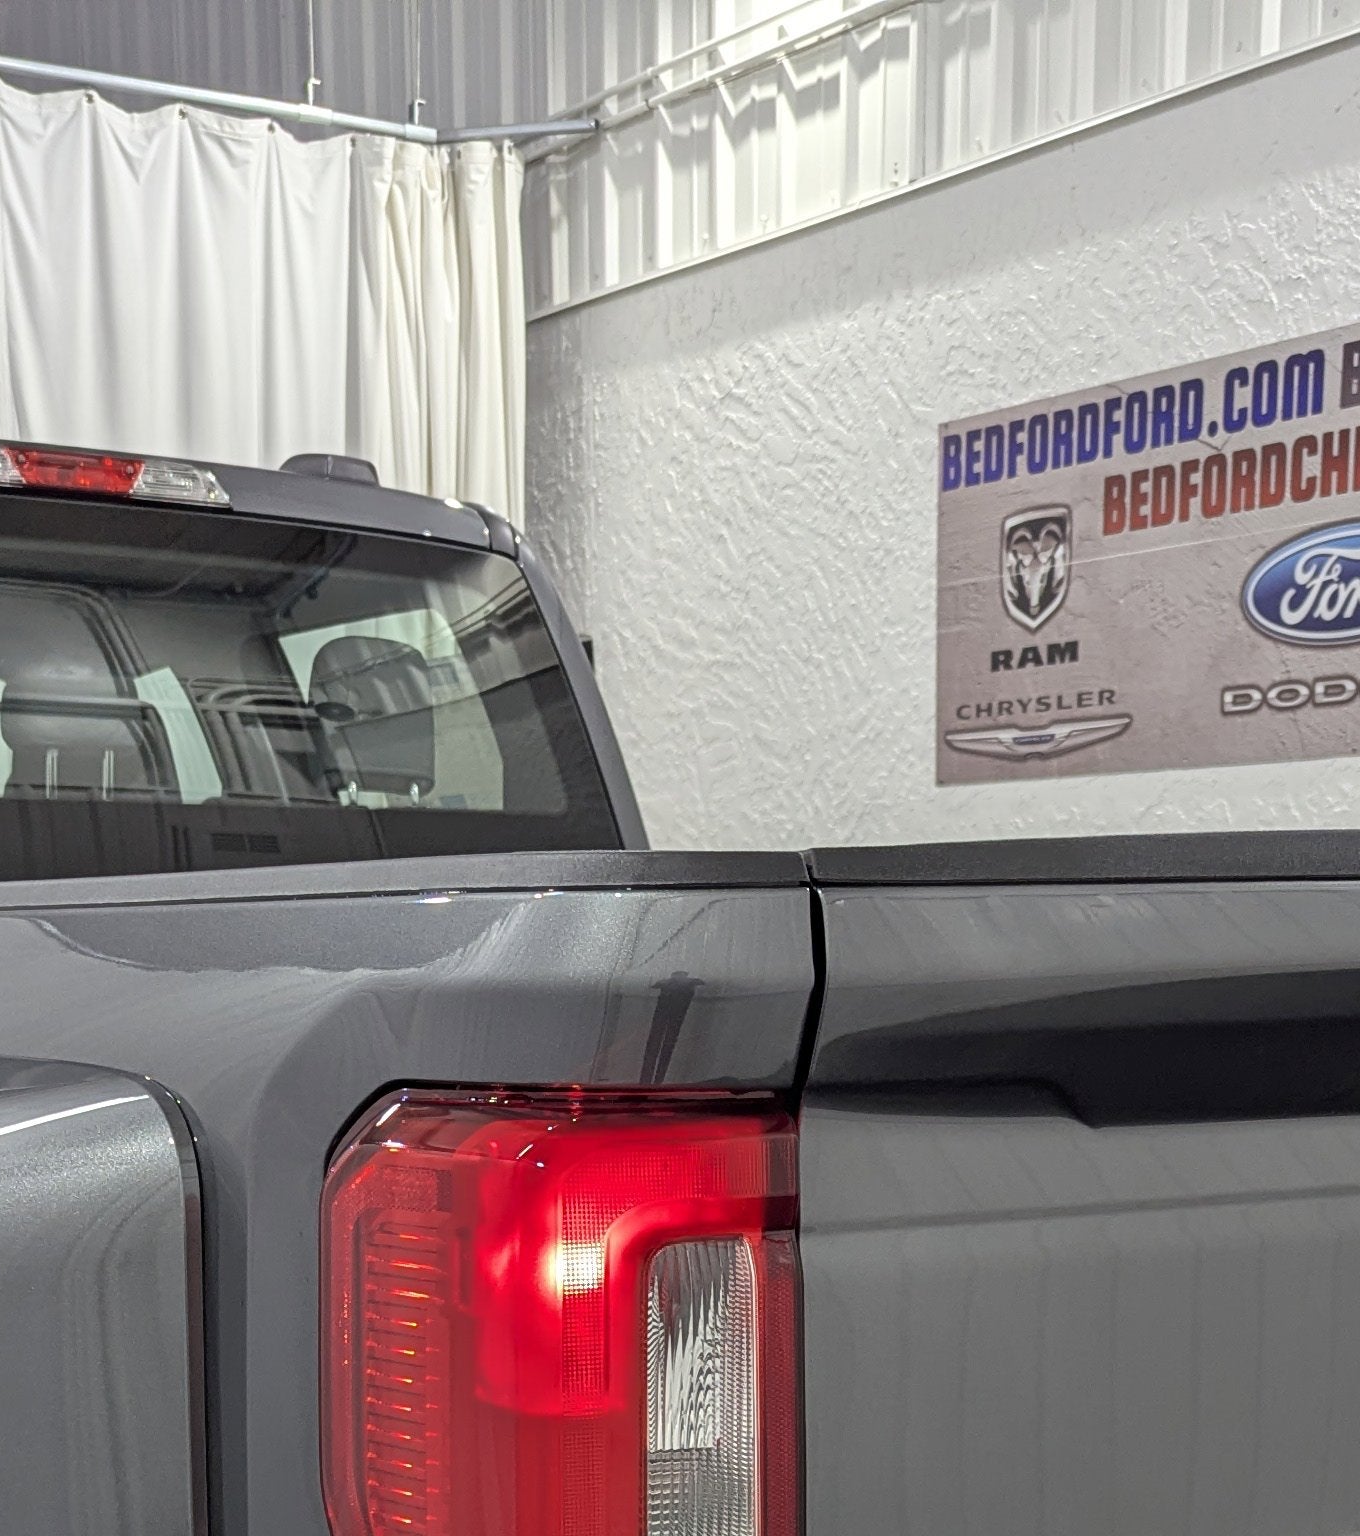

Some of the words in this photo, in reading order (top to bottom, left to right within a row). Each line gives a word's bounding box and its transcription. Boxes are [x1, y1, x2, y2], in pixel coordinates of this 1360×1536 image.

[942, 349, 1325, 493] BEDFORDFORD.COM
[990, 640, 1079, 673] RAM
[956, 689, 1117, 720] CHRYSLER
